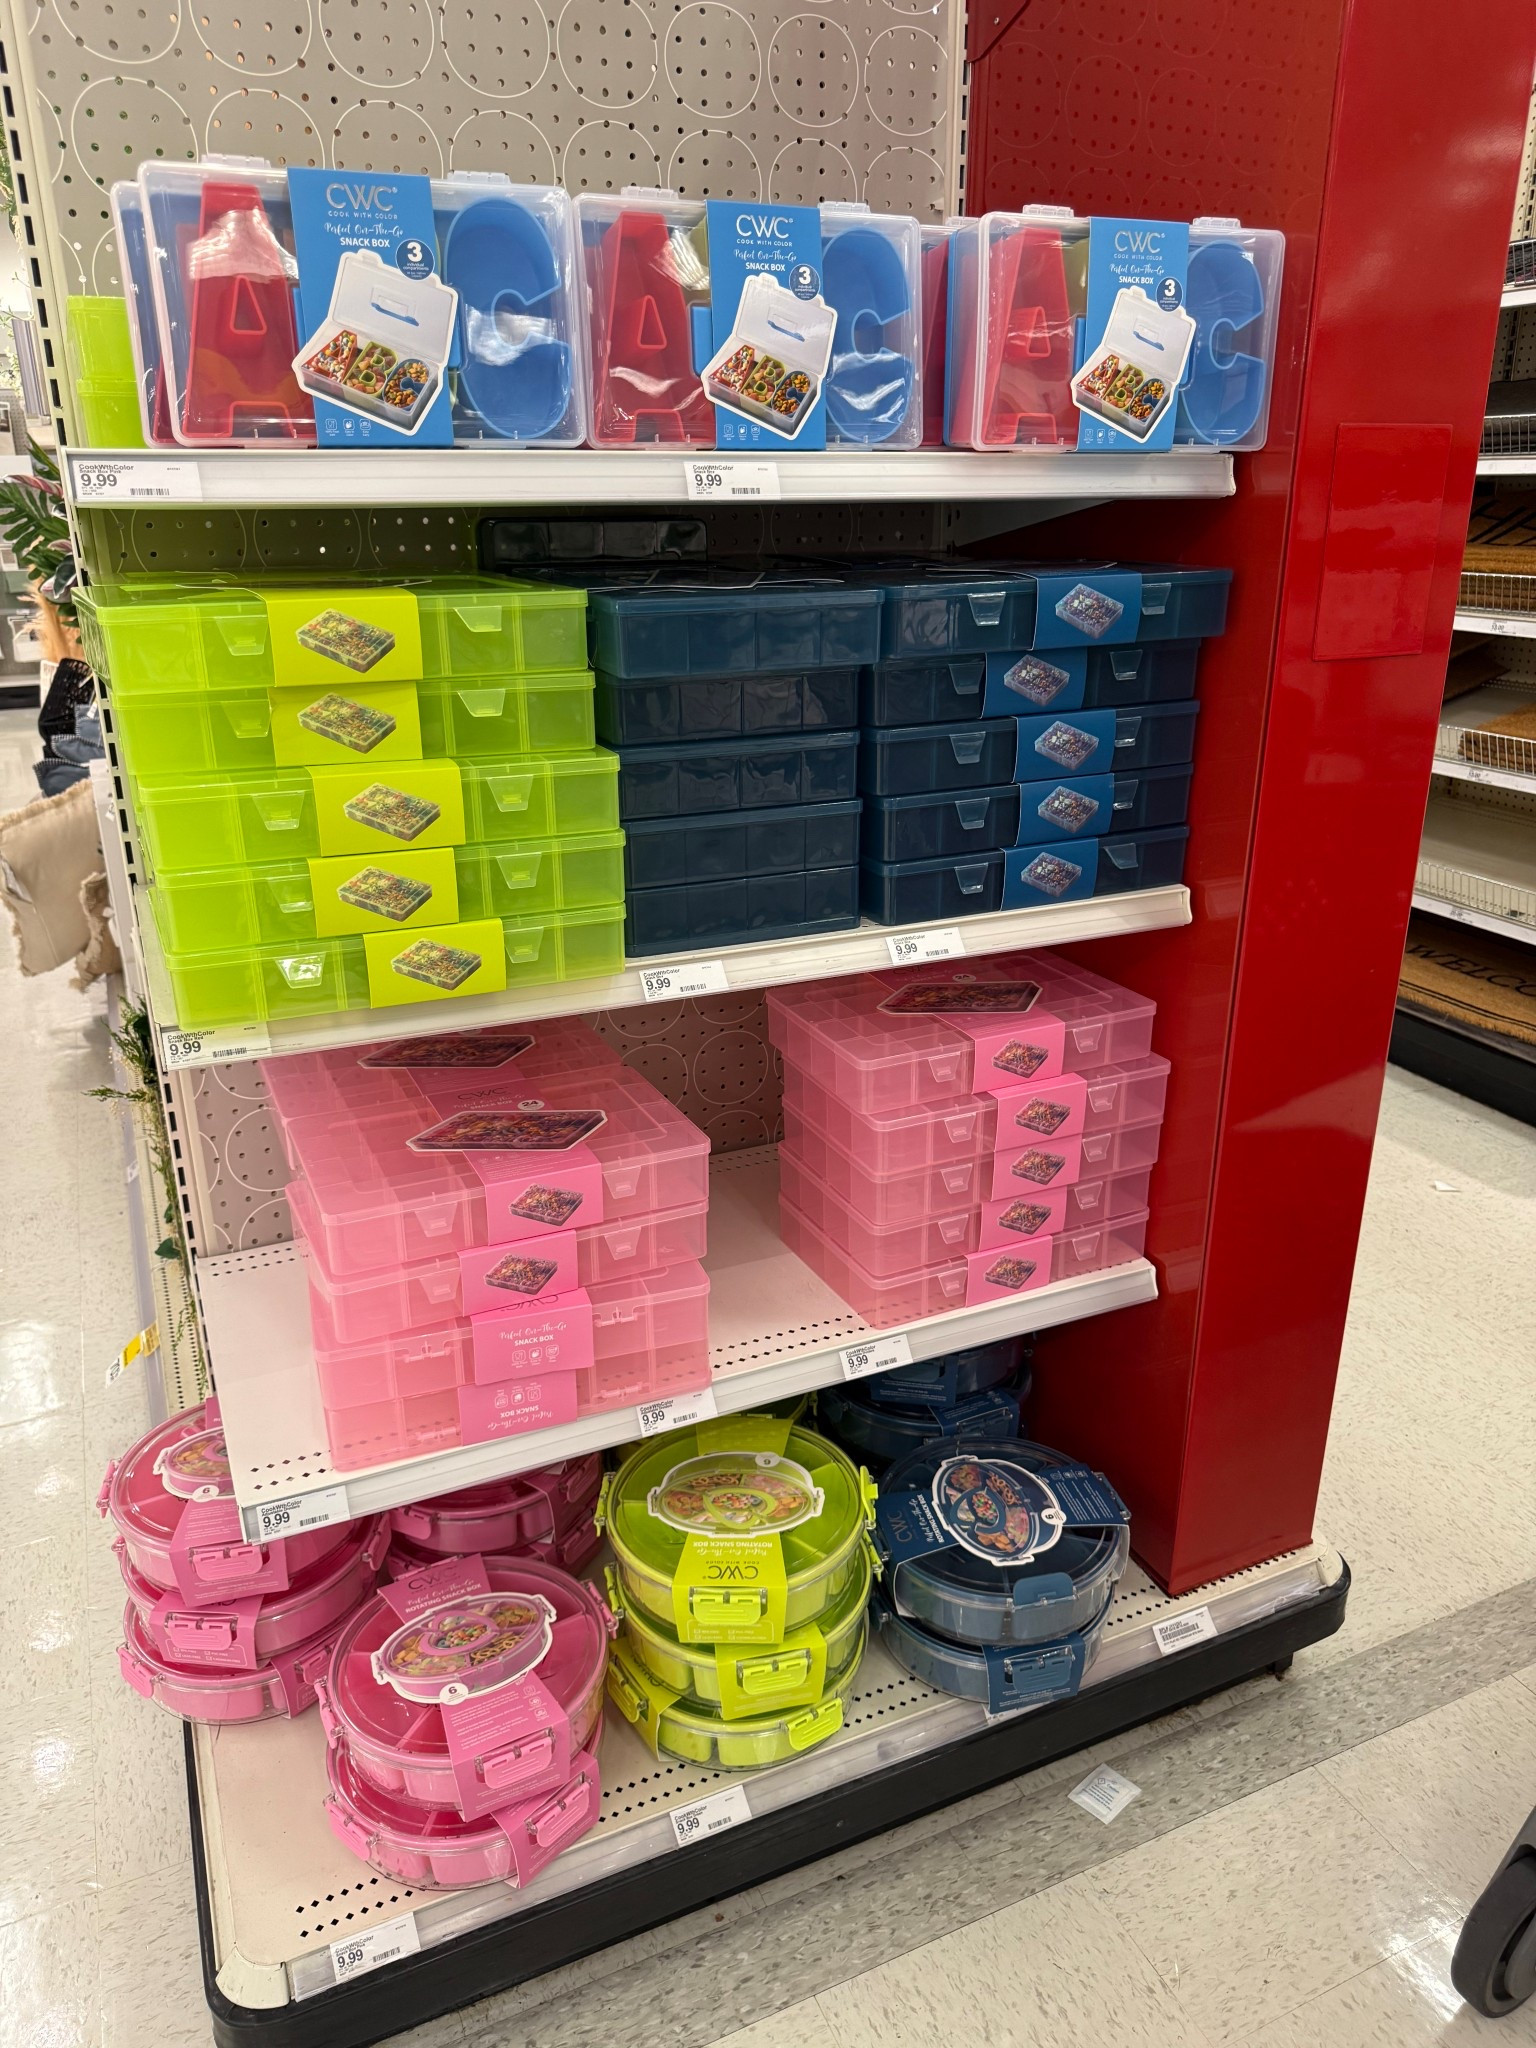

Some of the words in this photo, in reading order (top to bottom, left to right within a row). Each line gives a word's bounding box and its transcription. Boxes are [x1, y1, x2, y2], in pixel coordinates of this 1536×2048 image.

[326, 183, 394, 211] CWC
[328, 210, 349, 218] COOK
[324, 222, 351, 236] Perfect
[736, 214, 789, 239] CWC
[340, 237, 370, 247] SNACK
[372, 239, 390, 248] BOX
[1114, 230, 1161, 254] CWC
[407, 242, 423, 263] 3
[733, 249, 755, 261] Perfect
[745, 262, 770, 271] SNACK
[770, 264, 786, 272] BOX
[798, 266, 811, 285] 3
[1119, 275, 1140, 284] SNACK
[1164, 279, 1176, 297] 3
[80, 473, 118, 487] 9.99
[695, 474, 722, 487] 9.99
[895, 943, 918, 955] 9.99
[646, 978, 671, 991] 9.99
[170, 1041, 202, 1056] 9.99
[458, 1087, 504, 1100] CWC
[514, 1337, 538, 1347] SNACK
[848, 1354, 868, 1368] 9.99
[516, 1405, 539, 1416] SNACK
[642, 1410, 665, 1425] 9.99
[263, 1512, 290, 1528] 9.99
[887, 1510, 913, 1542] CWC
[707, 1565, 759, 1579] CWC
[405, 1597, 441, 1613] ROTATING
[442, 1589, 465, 1600] SNACK
[466, 1583, 482, 1591] BOX
[448, 1686, 457, 1694] 6
[677, 1817, 700, 1833] 9.99
[337, 1949, 363, 1968] 9.99
